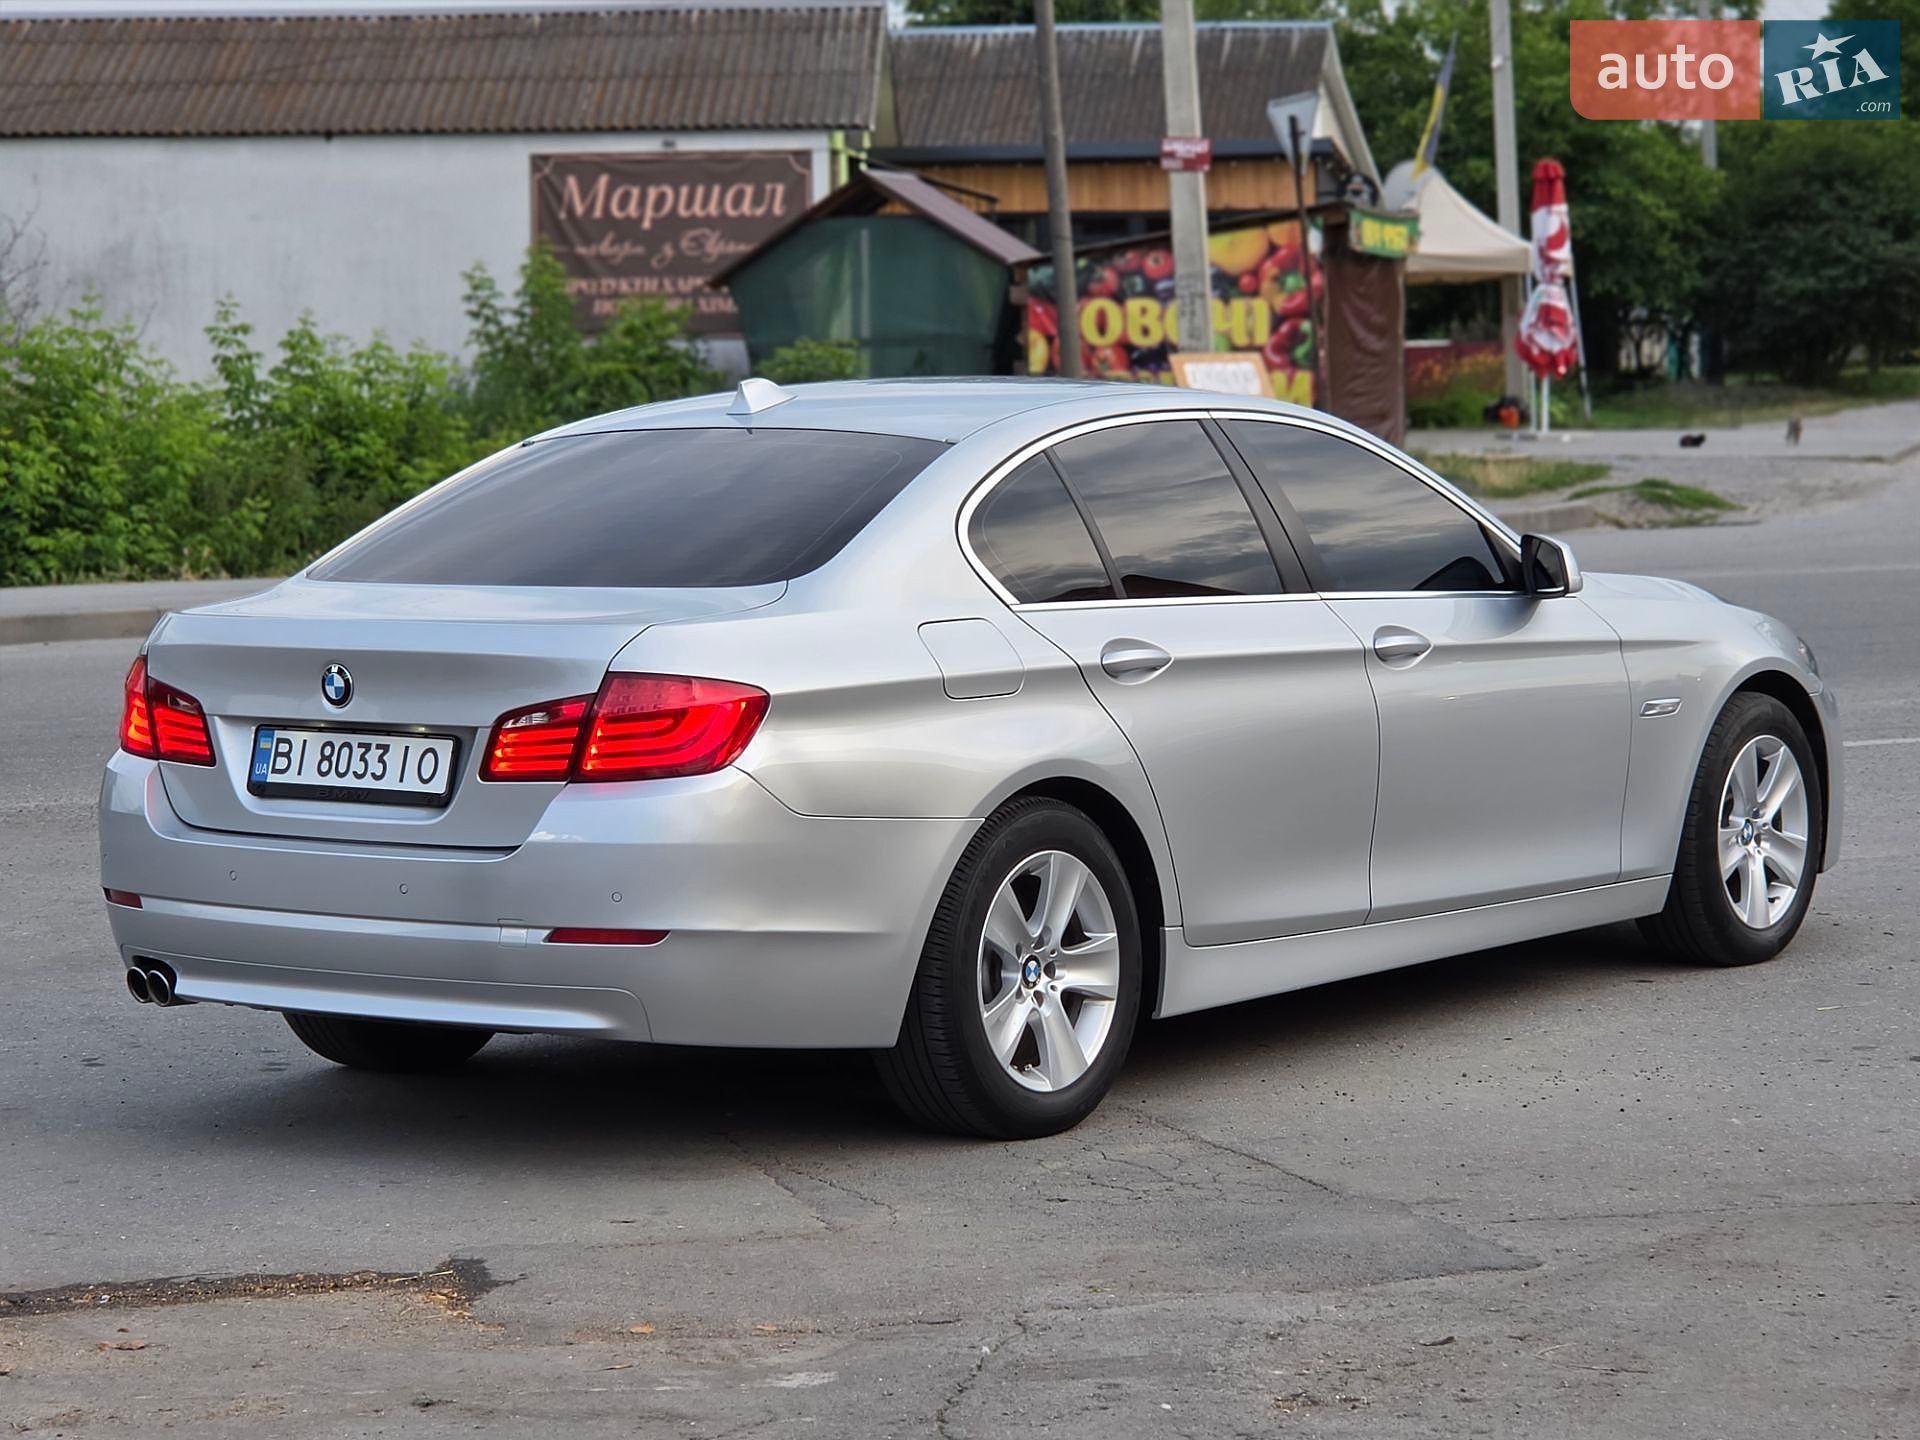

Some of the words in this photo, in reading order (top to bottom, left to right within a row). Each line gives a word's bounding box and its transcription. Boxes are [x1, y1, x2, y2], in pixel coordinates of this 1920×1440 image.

[558, 173, 786, 231] Маршал
[255, 762, 268, 775] UA
[270, 736, 307, 777] BI
[316, 740, 391, 782] 8033
